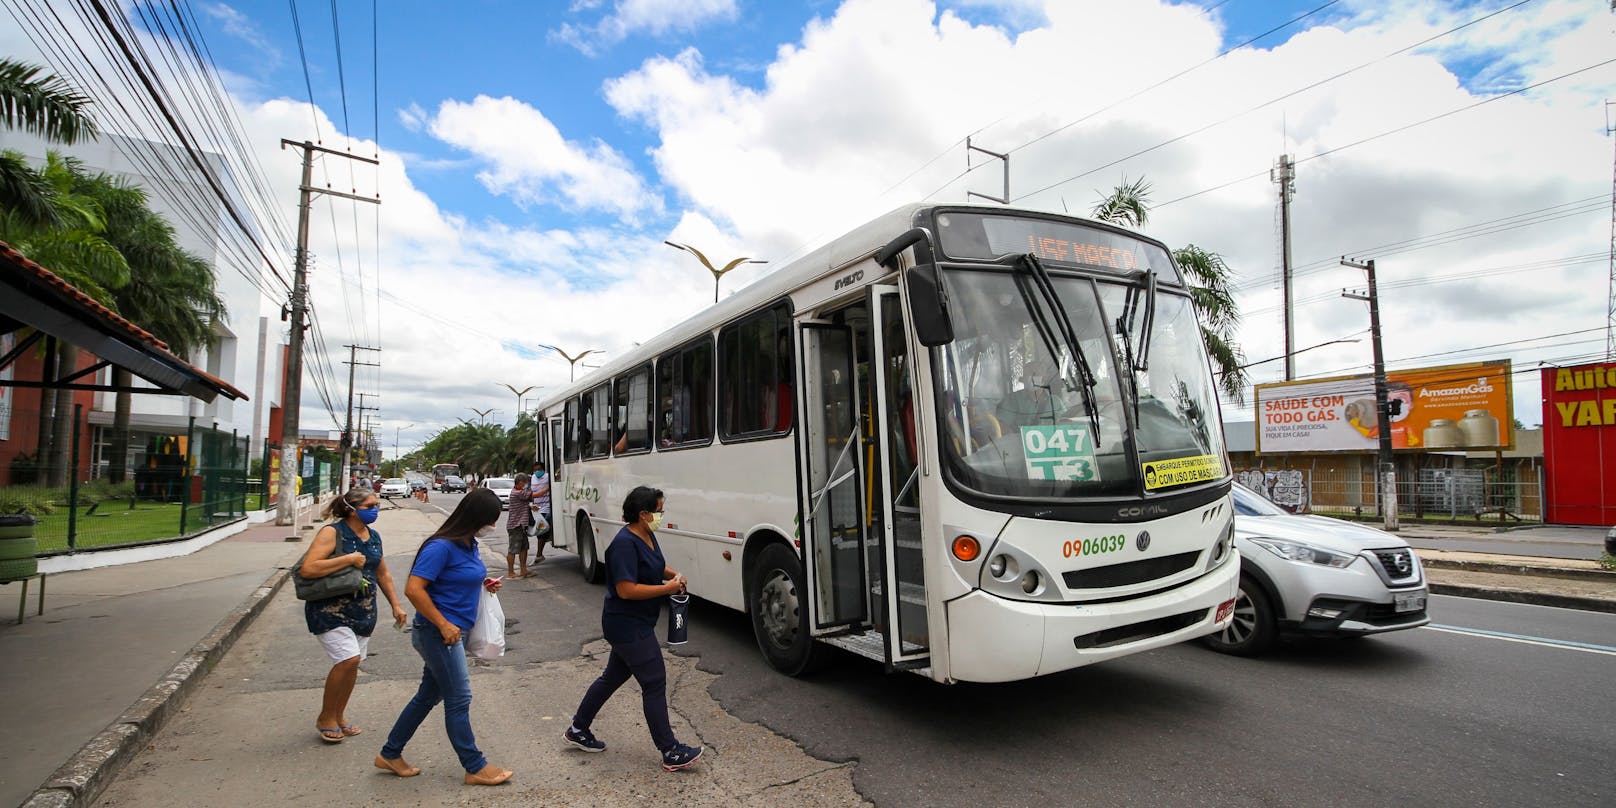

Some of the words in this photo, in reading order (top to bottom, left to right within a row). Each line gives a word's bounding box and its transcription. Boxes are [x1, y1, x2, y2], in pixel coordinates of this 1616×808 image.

[1312, 395, 1344, 408] COM
[1265, 412, 1303, 424] TODO
[1025, 429, 1086, 454] 047
[1158, 474, 1173, 485] COM
[1175, 471, 1188, 482] USO
[1189, 470, 1198, 481] DE
[1118, 506, 1168, 517] COMIL
[1062, 534, 1126, 558] 0906039
